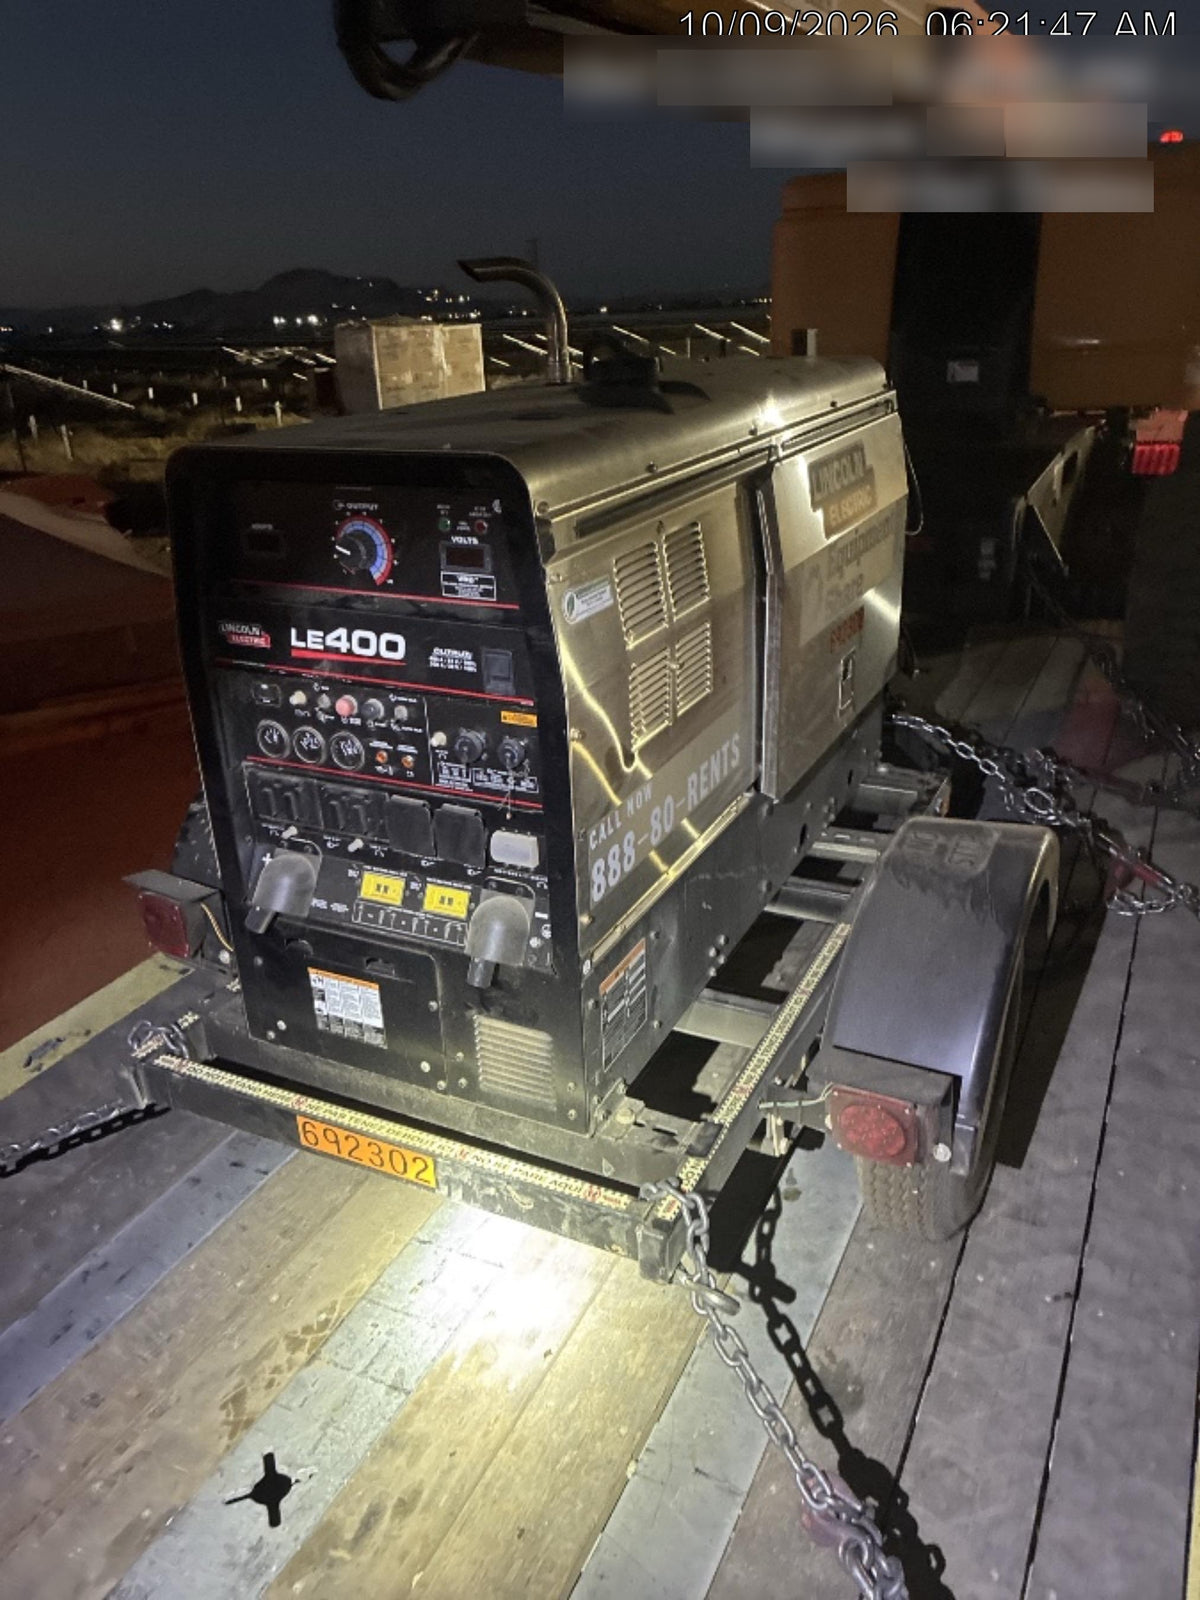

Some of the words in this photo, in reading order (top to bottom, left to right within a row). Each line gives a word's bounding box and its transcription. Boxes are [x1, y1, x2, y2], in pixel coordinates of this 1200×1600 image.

[812, 451, 865, 502] LINCOLN
[828, 485, 873, 526] ELECTRIC
[451, 535, 479, 545] VOLTS
[220, 623, 262, 636] LINCOLN
[291, 627, 406, 660] LE400
[589, 810, 622, 850] CALL
[626, 783, 652, 817] NOW
[591, 732, 740, 902] 888-80-RENTS
[302, 1121, 431, 1184] 692302
